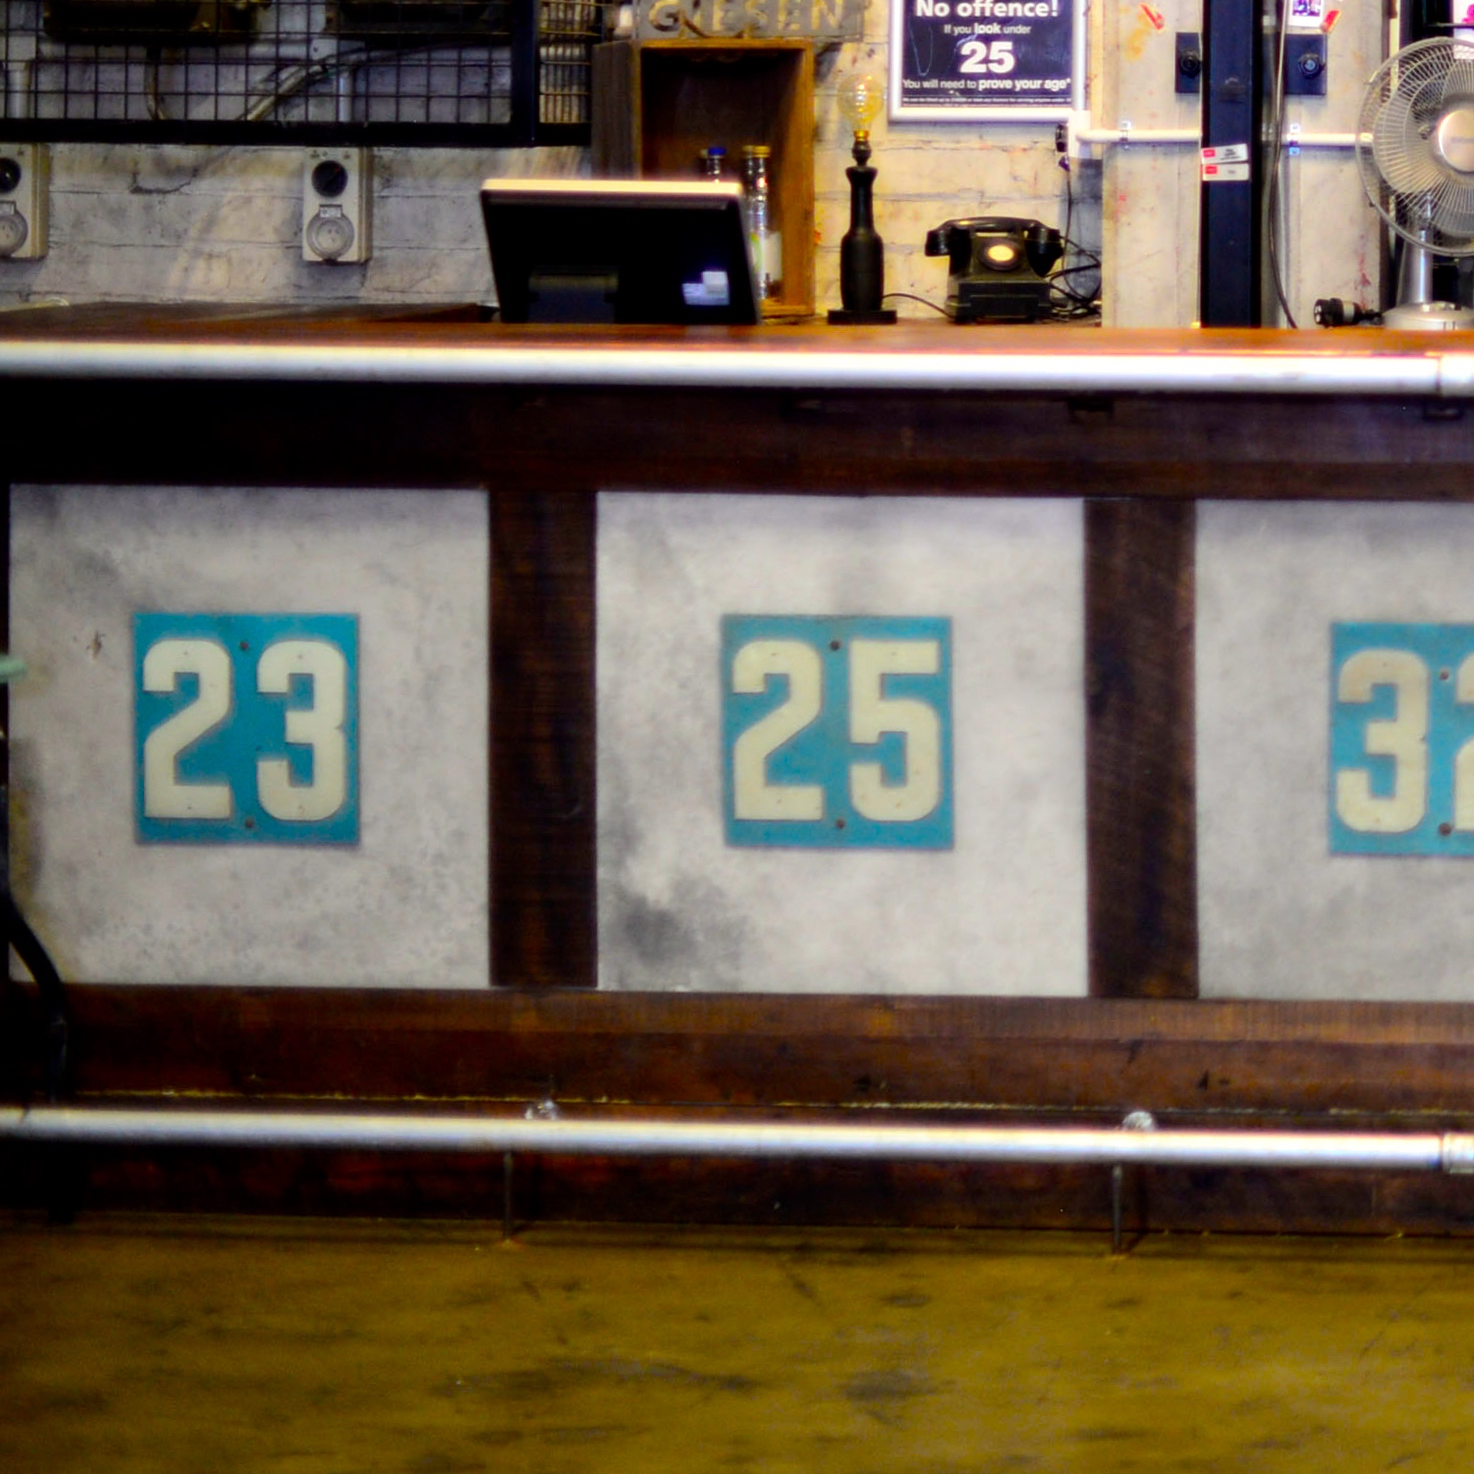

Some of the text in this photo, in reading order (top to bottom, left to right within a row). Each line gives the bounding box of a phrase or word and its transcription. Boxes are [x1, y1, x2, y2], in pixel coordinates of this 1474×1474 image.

[943, 23, 1032, 36] If you look under
[960, 41, 1015, 74] 25
[903, 79, 921, 89] You
[922, 79, 938, 89] will
[940, 79, 965, 89] need
[967, 80, 977, 89] to
[978, 80, 1013, 91] prove
[1015, 81, 1042, 91] your
[142, 636, 351, 824] 23
[732, 633, 944, 826] 25
